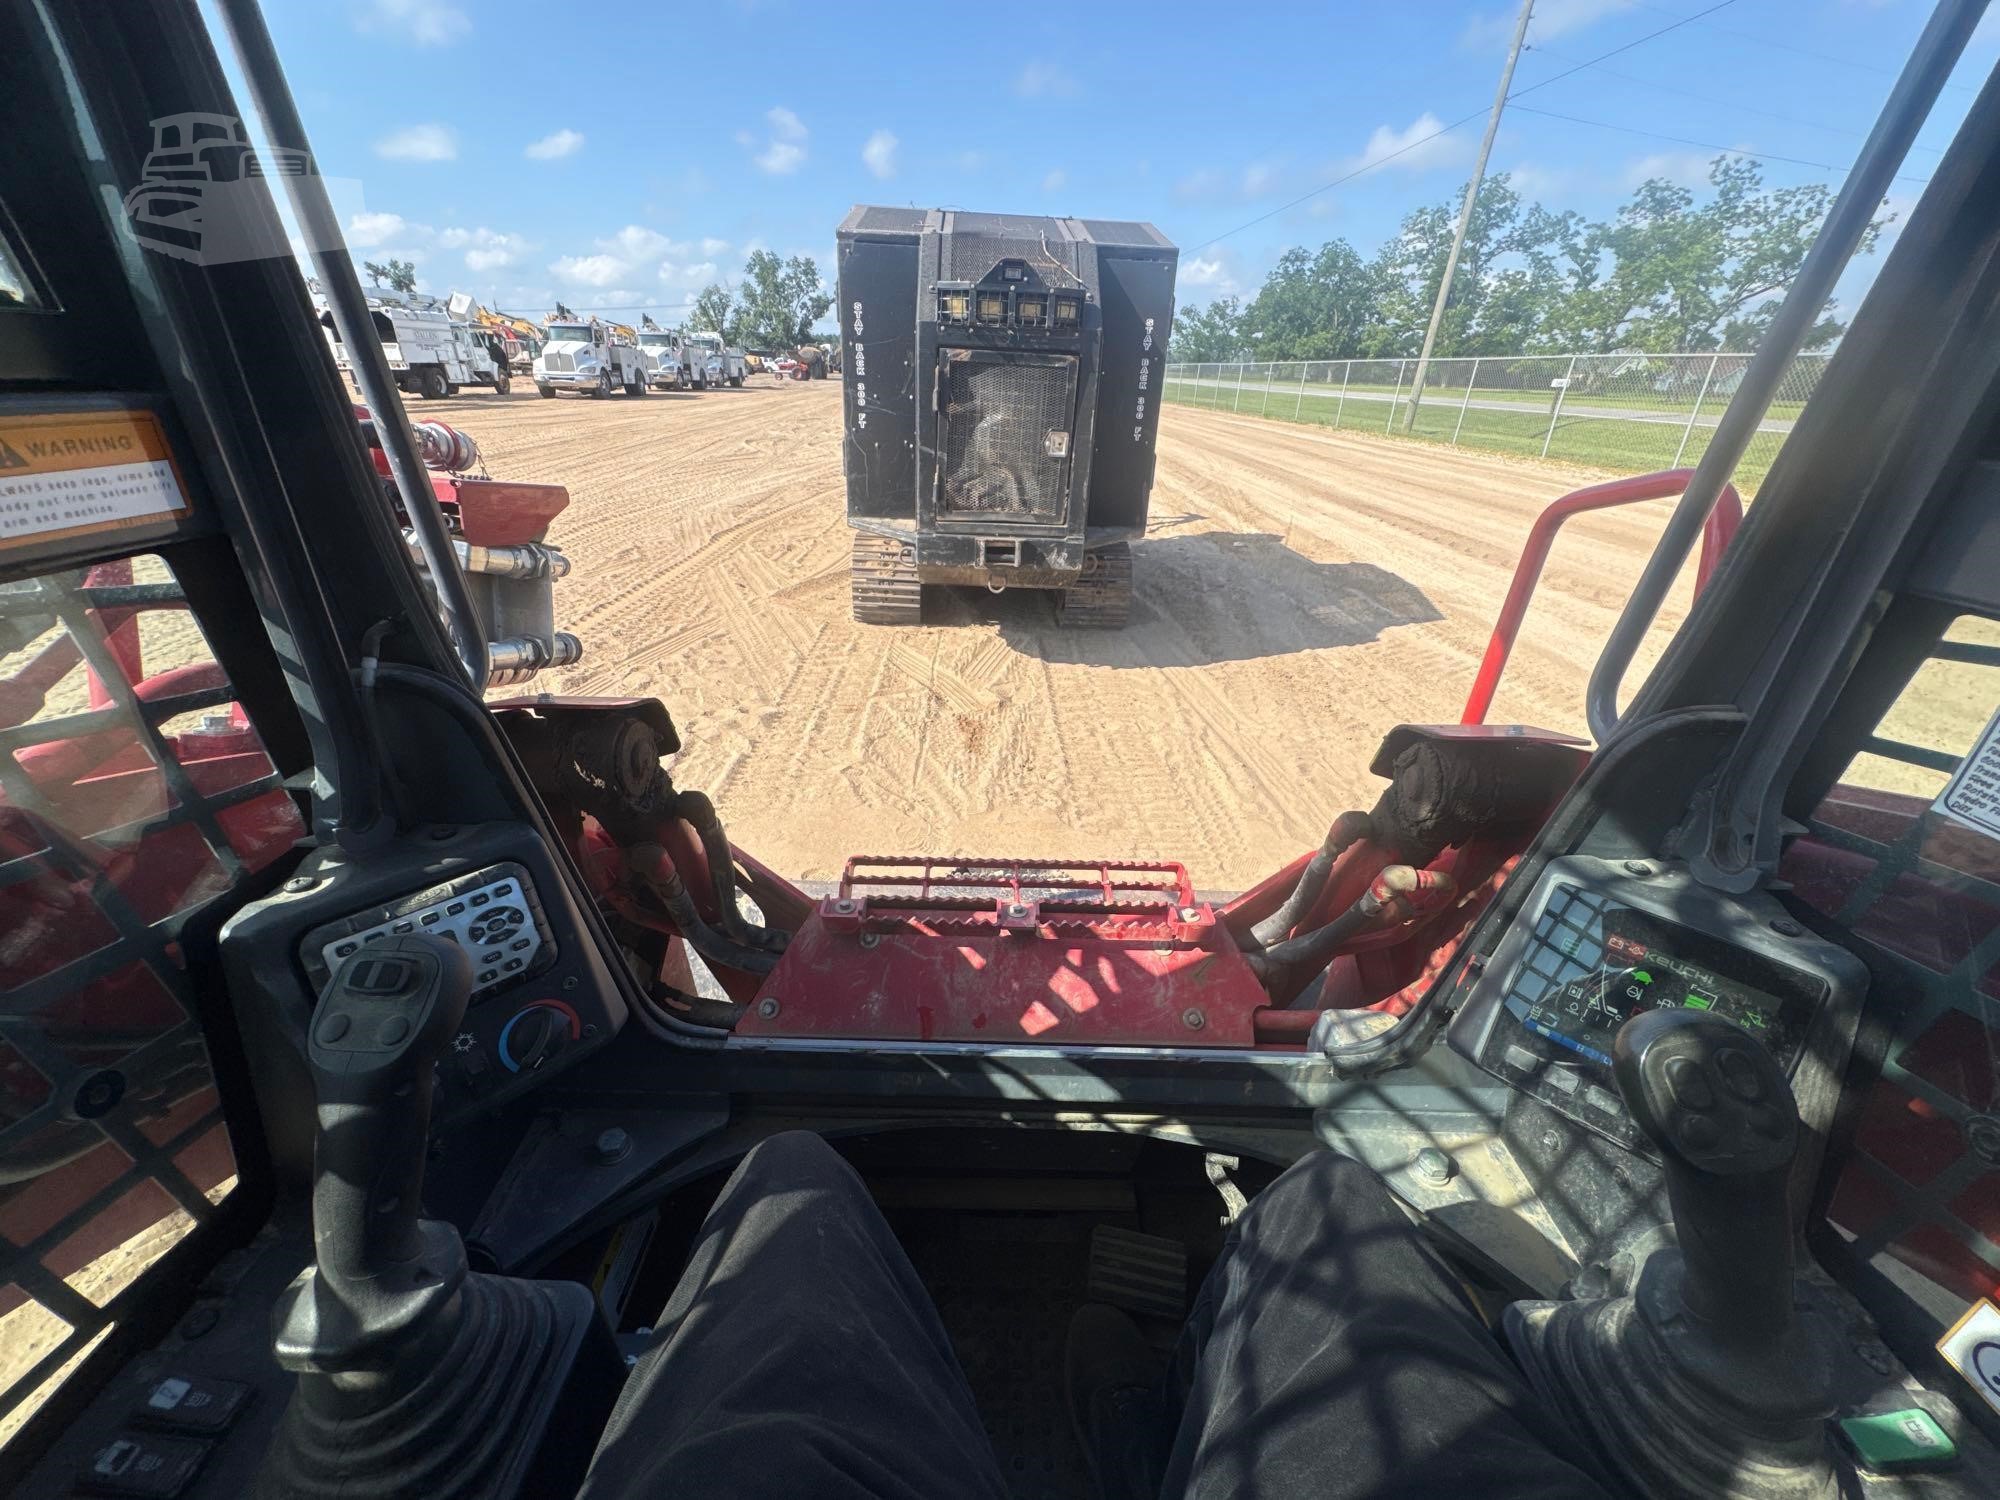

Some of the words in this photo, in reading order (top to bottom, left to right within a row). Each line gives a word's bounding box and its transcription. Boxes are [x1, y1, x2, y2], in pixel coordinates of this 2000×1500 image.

[853, 301, 864, 335] STAY
[1143, 318, 1154, 350] STAY
[855, 343, 865, 375] BACK
[1139, 358, 1149, 389] BACK
[857, 383, 866, 406] 300
[1136, 397, 1145, 419] 300
[858, 412, 867, 428] FT
[1133, 426, 1142, 441] FT
[25, 434, 132, 458] WARNING
[0, 482, 42, 496] LWAYS
